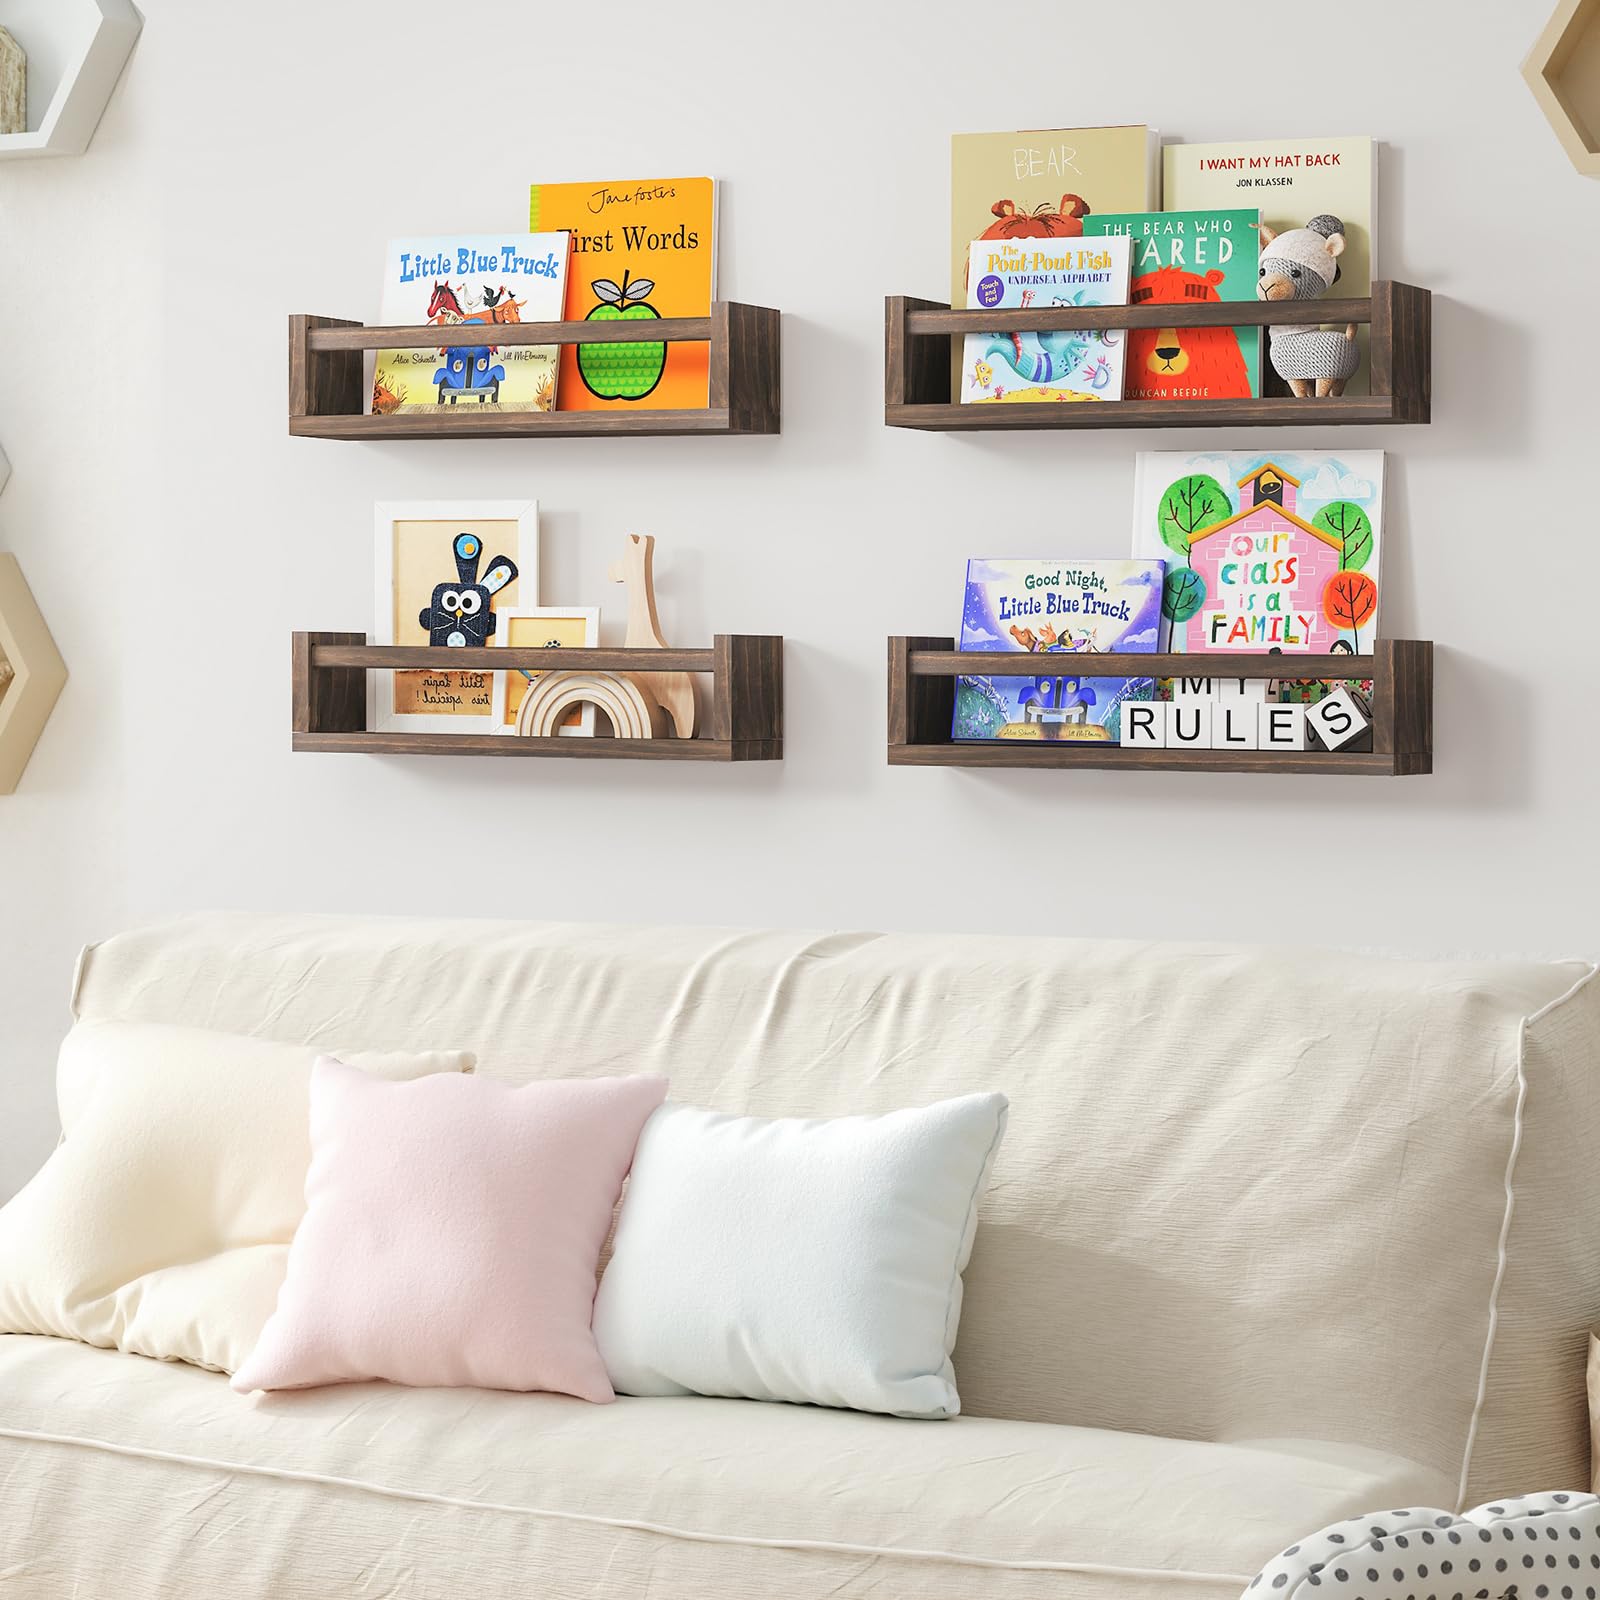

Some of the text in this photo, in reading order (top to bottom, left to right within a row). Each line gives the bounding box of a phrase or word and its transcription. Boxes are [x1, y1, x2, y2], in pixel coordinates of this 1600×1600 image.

[1014, 144, 1082, 180] BEAR
[1199, 153, 1341, 170] I WANT MY HAT BACK
[1236, 177, 1293, 187] JON KLASSEN
[587, 188, 631, 213] Jane
[1103, 219, 1232, 236] THE BEAR WHO
[556, 224, 698, 253] irst Words
[1002, 245, 1019, 256] The
[400, 246, 559, 283] Little Blue Truck
[987, 250, 1112, 273] Pout-Pout Fish
[980, 280, 999, 291] Touch
[1008, 272, 1112, 285] UNDERSEA ALPHABET
[984, 289, 997, 297] and
[985, 295, 998, 304] Feel
[392, 354, 410, 365] Alice
[500, 352, 513, 361] Jill
[1173, 387, 1208, 397] BEEDIE
[1025, 570, 1107, 593] Good Night,
[999, 593, 1130, 621] Little Blue Truck
[1239, 591, 1281, 612] is a
[1211, 614, 1316, 645] FAMILY
[1129, 701, 1352, 743] RULES
